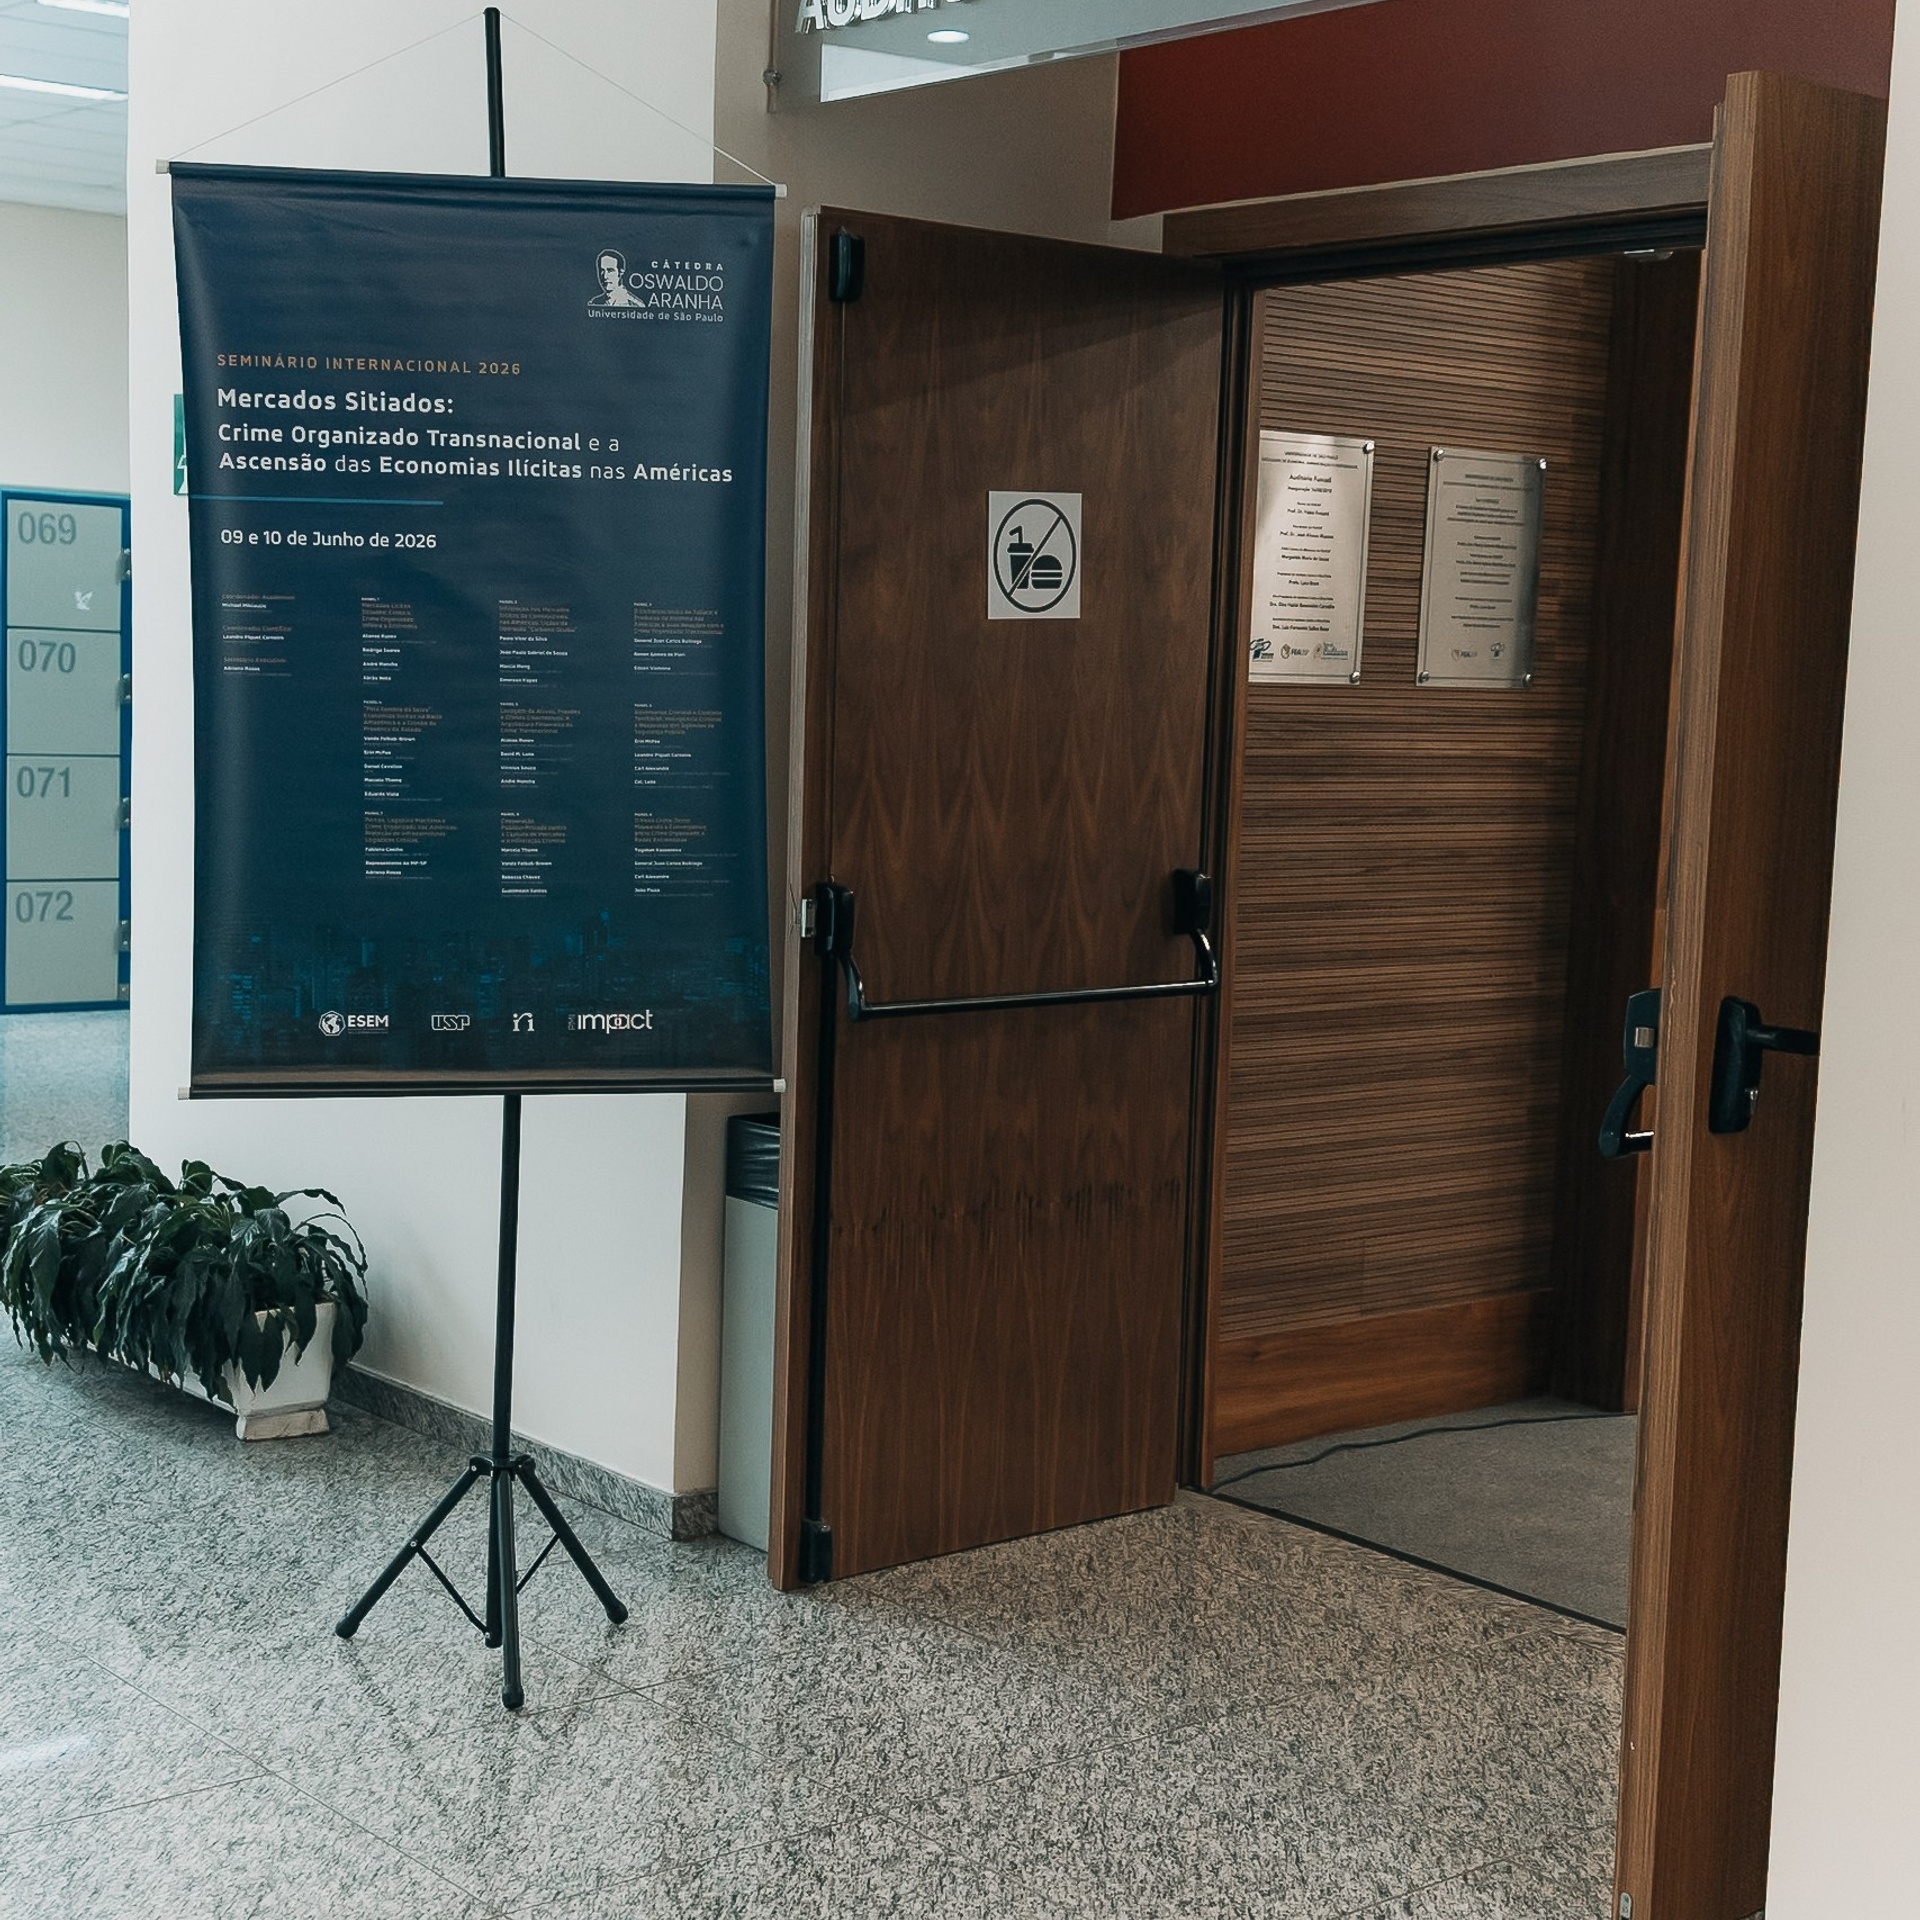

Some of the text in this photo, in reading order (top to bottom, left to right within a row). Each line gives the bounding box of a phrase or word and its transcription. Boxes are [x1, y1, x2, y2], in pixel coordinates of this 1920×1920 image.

[650, 259, 724, 272] CÁTEDRA
[629, 273, 724, 292] OSWALDO
[647, 292, 724, 310] ARANHA
[587, 308, 724, 323] Universidade de São Paulo
[217, 353, 520, 375] SEMINÁRIO INTERNACIONAL 2026
[217, 388, 454, 414] Mercados Sitiados:
[218, 423, 619, 453] Crime Organizado Transnacional e a
[219, 453, 733, 483] Ascensão das Economias Ilícitas nas Américas
[18, 511, 77, 546] 069
[220, 529, 438, 549] 09 e 10 de Junho de 2026
[18, 639, 76, 674] 070
[16, 766, 71, 799] 071
[15, 890, 75, 924] 072
[347, 1014, 389, 1028] ESEM
[431, 1014, 471, 1031] USP
[577, 1008, 654, 1035] impact
